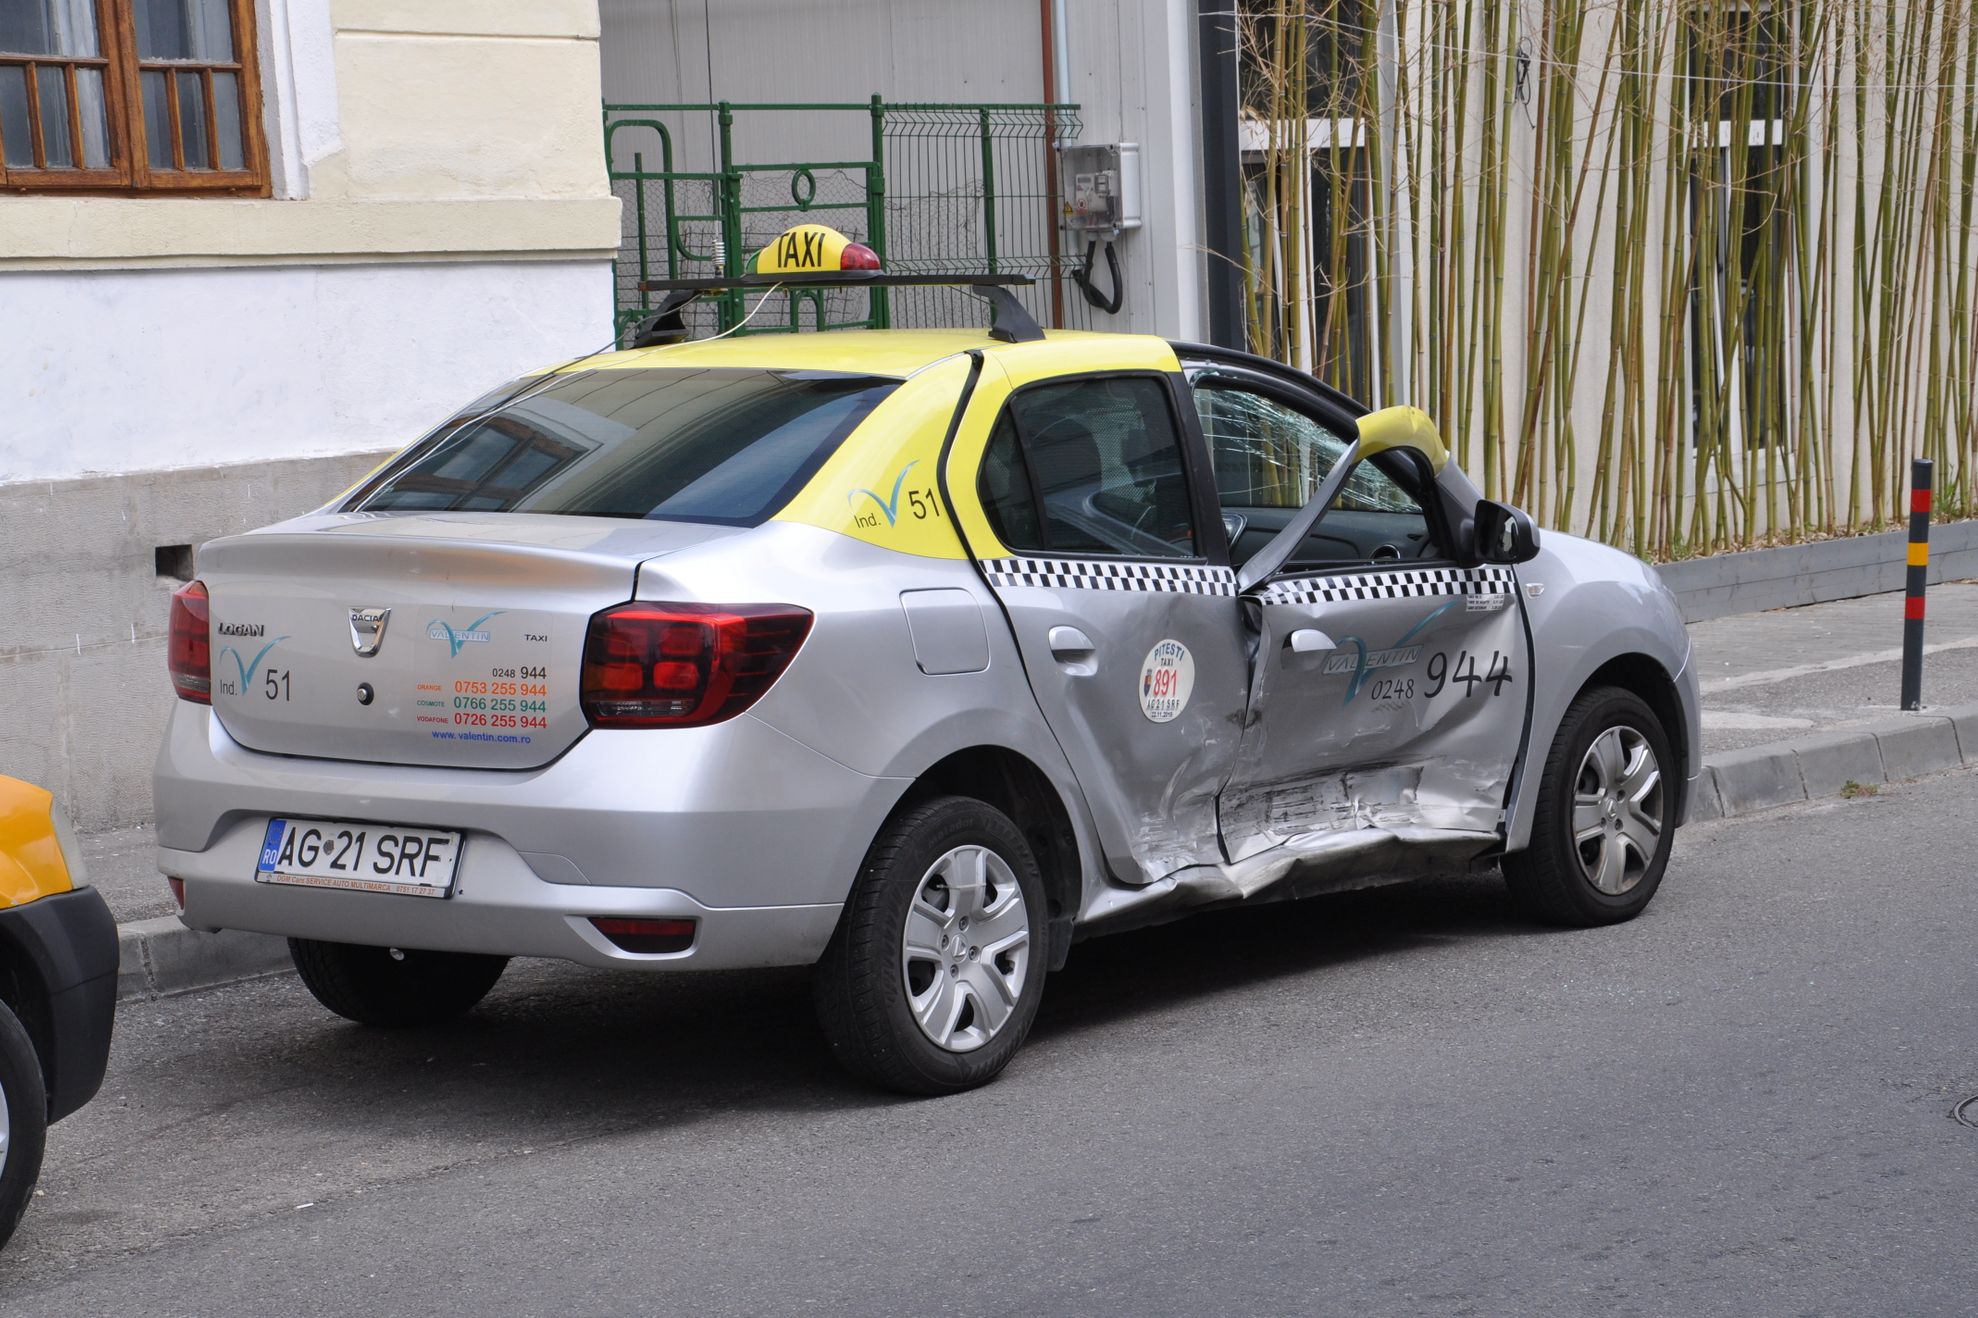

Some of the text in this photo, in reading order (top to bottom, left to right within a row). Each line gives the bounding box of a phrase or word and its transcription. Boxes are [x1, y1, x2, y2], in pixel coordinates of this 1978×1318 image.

[777, 231, 826, 268] TAXI
[853, 488, 940, 529] Ind. 51
[351, 614, 380, 622] DACIA
[218, 622, 265, 637] LOGAN
[432, 631, 489, 641] VALENTIN
[524, 633, 548, 642] TAXI
[1160, 657, 1174, 667] TAXI
[1327, 648, 1419, 672] VALENTIN
[492, 666, 547, 679] 0248 944
[1371, 650, 1513, 700] 0248 944
[219, 668, 290, 701] Ind. 51
[417, 680, 547, 697] ORANGE 0753 255 944
[1153, 669, 1178, 697] 891
[416, 696, 547, 713] COSMOTE 0766 255 944
[1166, 698, 1180, 710] SRF
[416, 712, 547, 729] VODAFONE 0726 255 944
[262, 849, 277, 864] RO
[277, 826, 450, 878] AG 21 SRF
[306, 877, 332, 886] SERVICE
[333, 879, 350, 887] AUTO
[350, 881, 391, 892] MULTIMARCA
